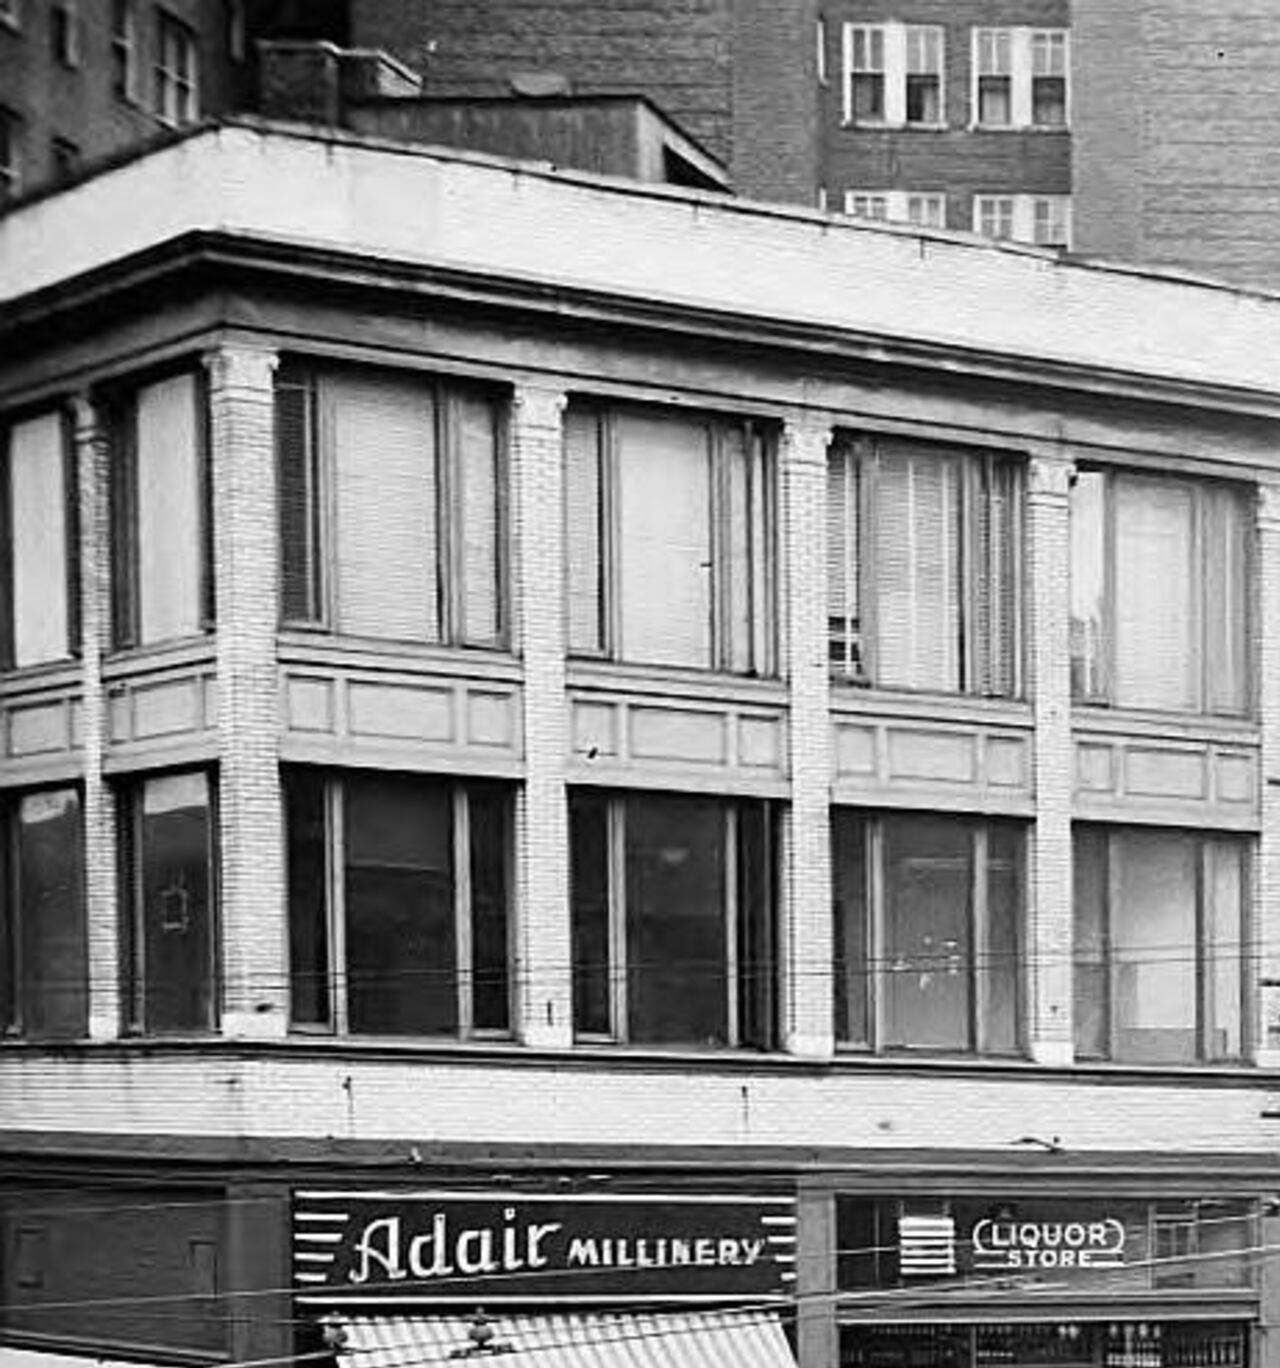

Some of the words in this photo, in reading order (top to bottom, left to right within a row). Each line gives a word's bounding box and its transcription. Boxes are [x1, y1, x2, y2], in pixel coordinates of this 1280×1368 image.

[348, 1207, 564, 1284] Adair
[567, 1237, 766, 1267] MILLINERY
[992, 1223, 1107, 1248] LIQUOR
[1008, 1250, 1092, 1268] STORE
